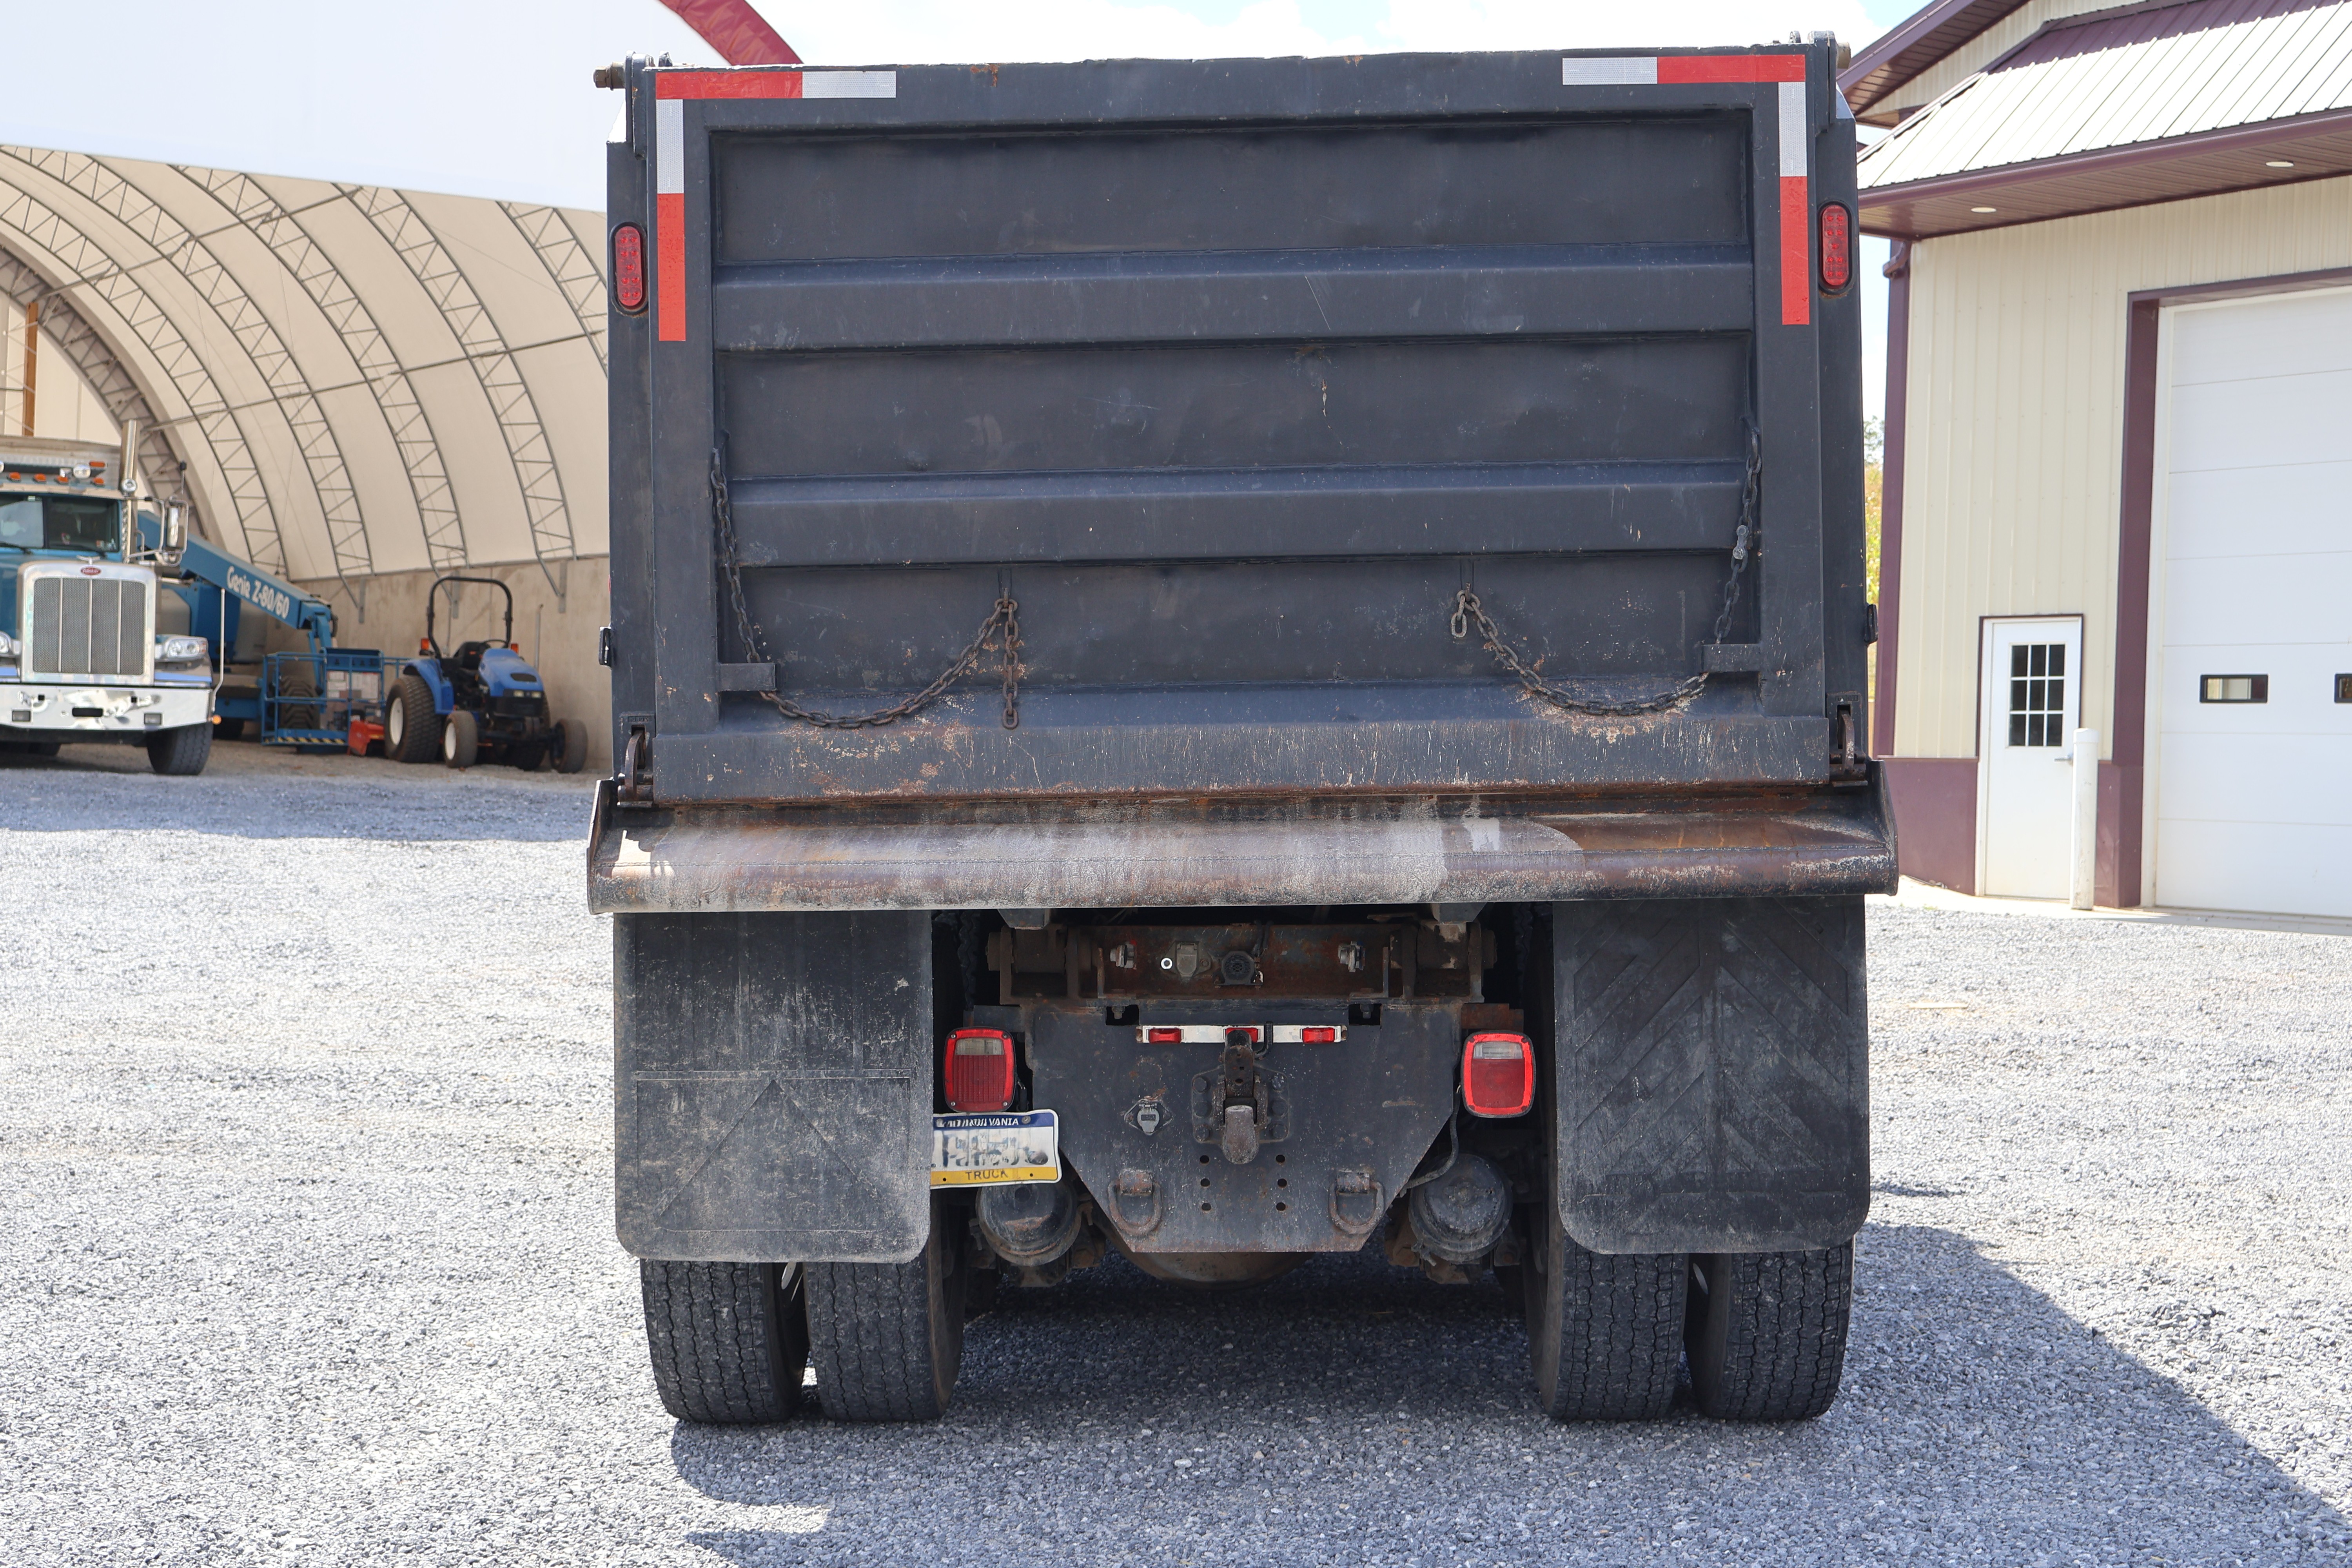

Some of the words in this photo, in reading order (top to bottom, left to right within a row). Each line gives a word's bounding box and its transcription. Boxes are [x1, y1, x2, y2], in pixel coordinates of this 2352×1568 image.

[227, 565, 251, 599] Genie
[252, 580, 290, 619] Z-80/60
[965, 1170, 1009, 1180] TRUCK
